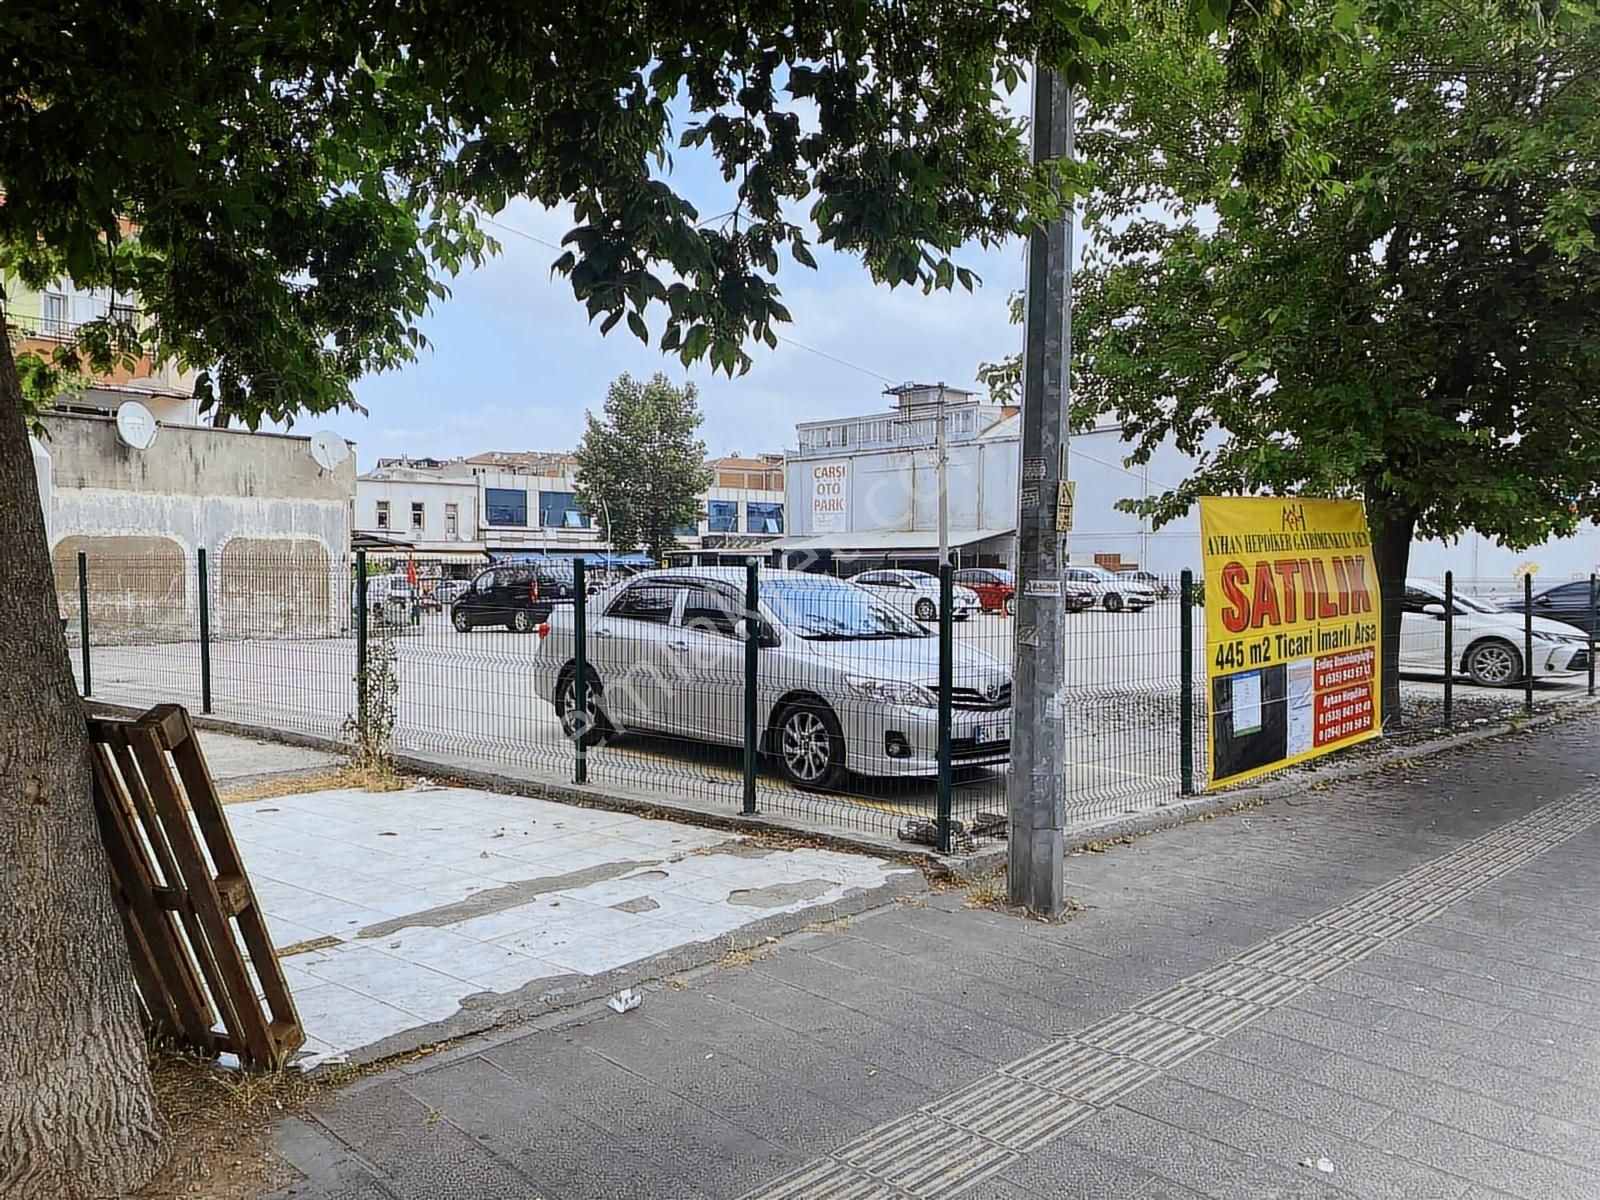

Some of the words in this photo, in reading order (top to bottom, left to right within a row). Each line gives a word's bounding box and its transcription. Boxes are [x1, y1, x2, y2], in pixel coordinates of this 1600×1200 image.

[817, 483, 841, 495] OTO
[814, 499, 844, 511] PARK
[1207, 534, 1243, 555] AYHAN
[1221, 555, 1372, 633] SATILIK
[1216, 641, 1244, 670] 445
[1250, 636, 1271, 664] m2
[1275, 628, 1313, 659] Ticari
[1354, 621, 1377, 645] Arsa
